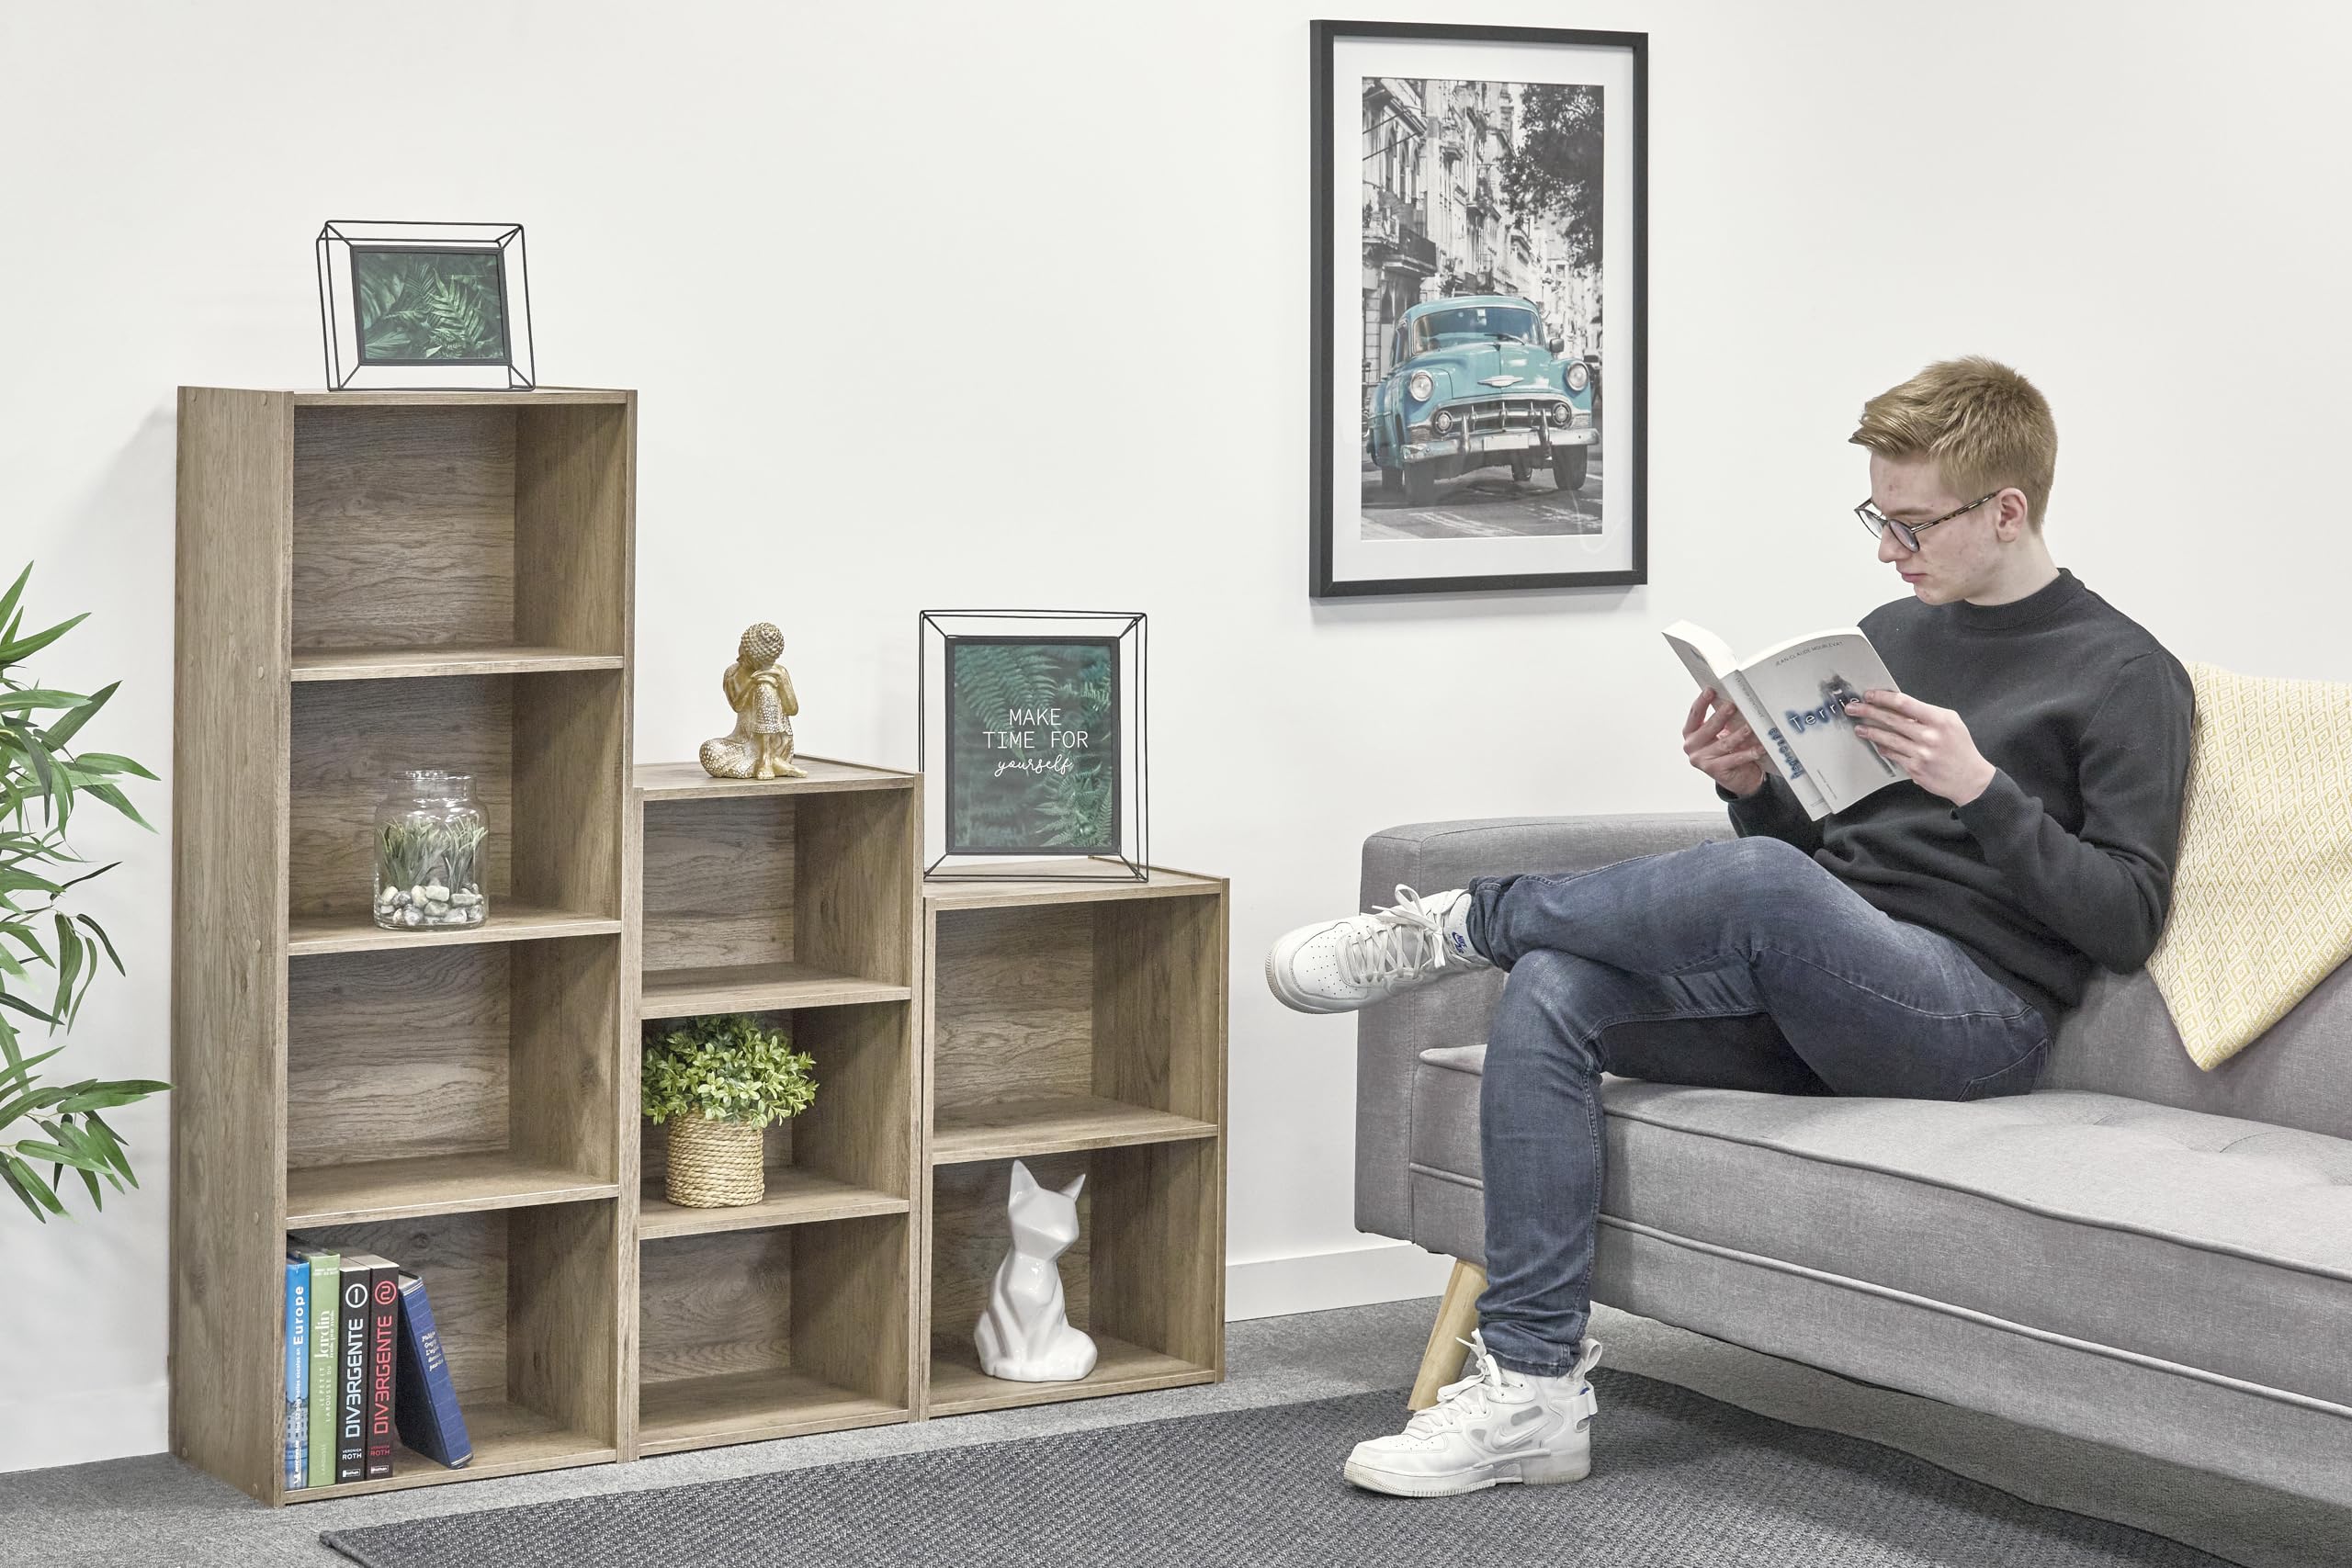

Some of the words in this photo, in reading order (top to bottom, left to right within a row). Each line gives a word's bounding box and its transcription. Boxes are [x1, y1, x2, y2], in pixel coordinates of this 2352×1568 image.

[1009, 707, 1062, 726] MAKE
[982, 731, 1035, 749] TIME
[1051, 730, 1089, 749] FOR
[994, 753, 1073, 777] yourself
[293, 1286, 306, 1346] Europe
